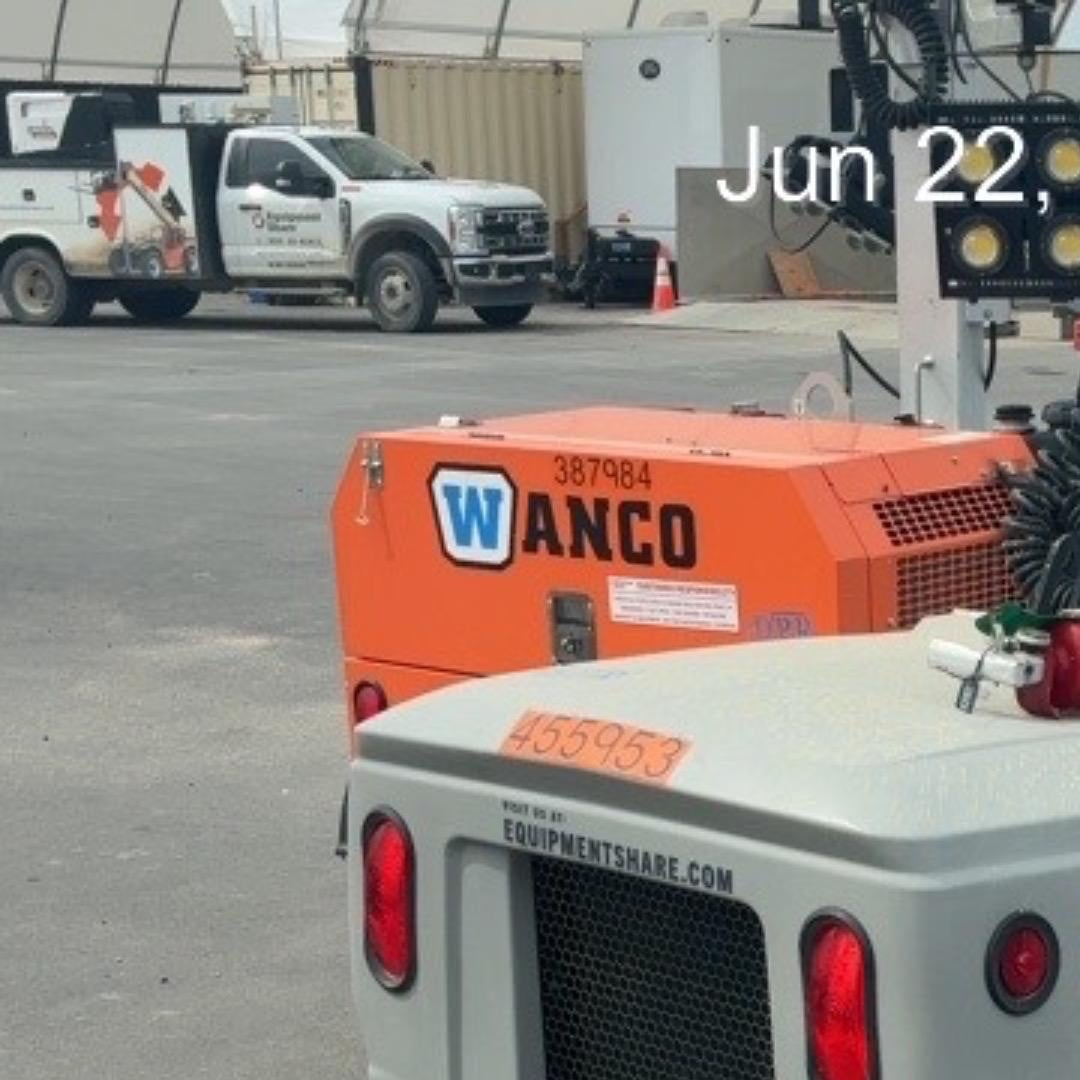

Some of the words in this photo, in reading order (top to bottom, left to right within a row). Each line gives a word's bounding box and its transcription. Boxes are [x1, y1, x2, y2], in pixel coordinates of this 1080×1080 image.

[554, 455, 651, 489] 387984
[442, 484, 698, 570] WANCO
[508, 715, 683, 778] 455953
[503, 818, 734, 895] EQUIPMENTSHARE.COM
